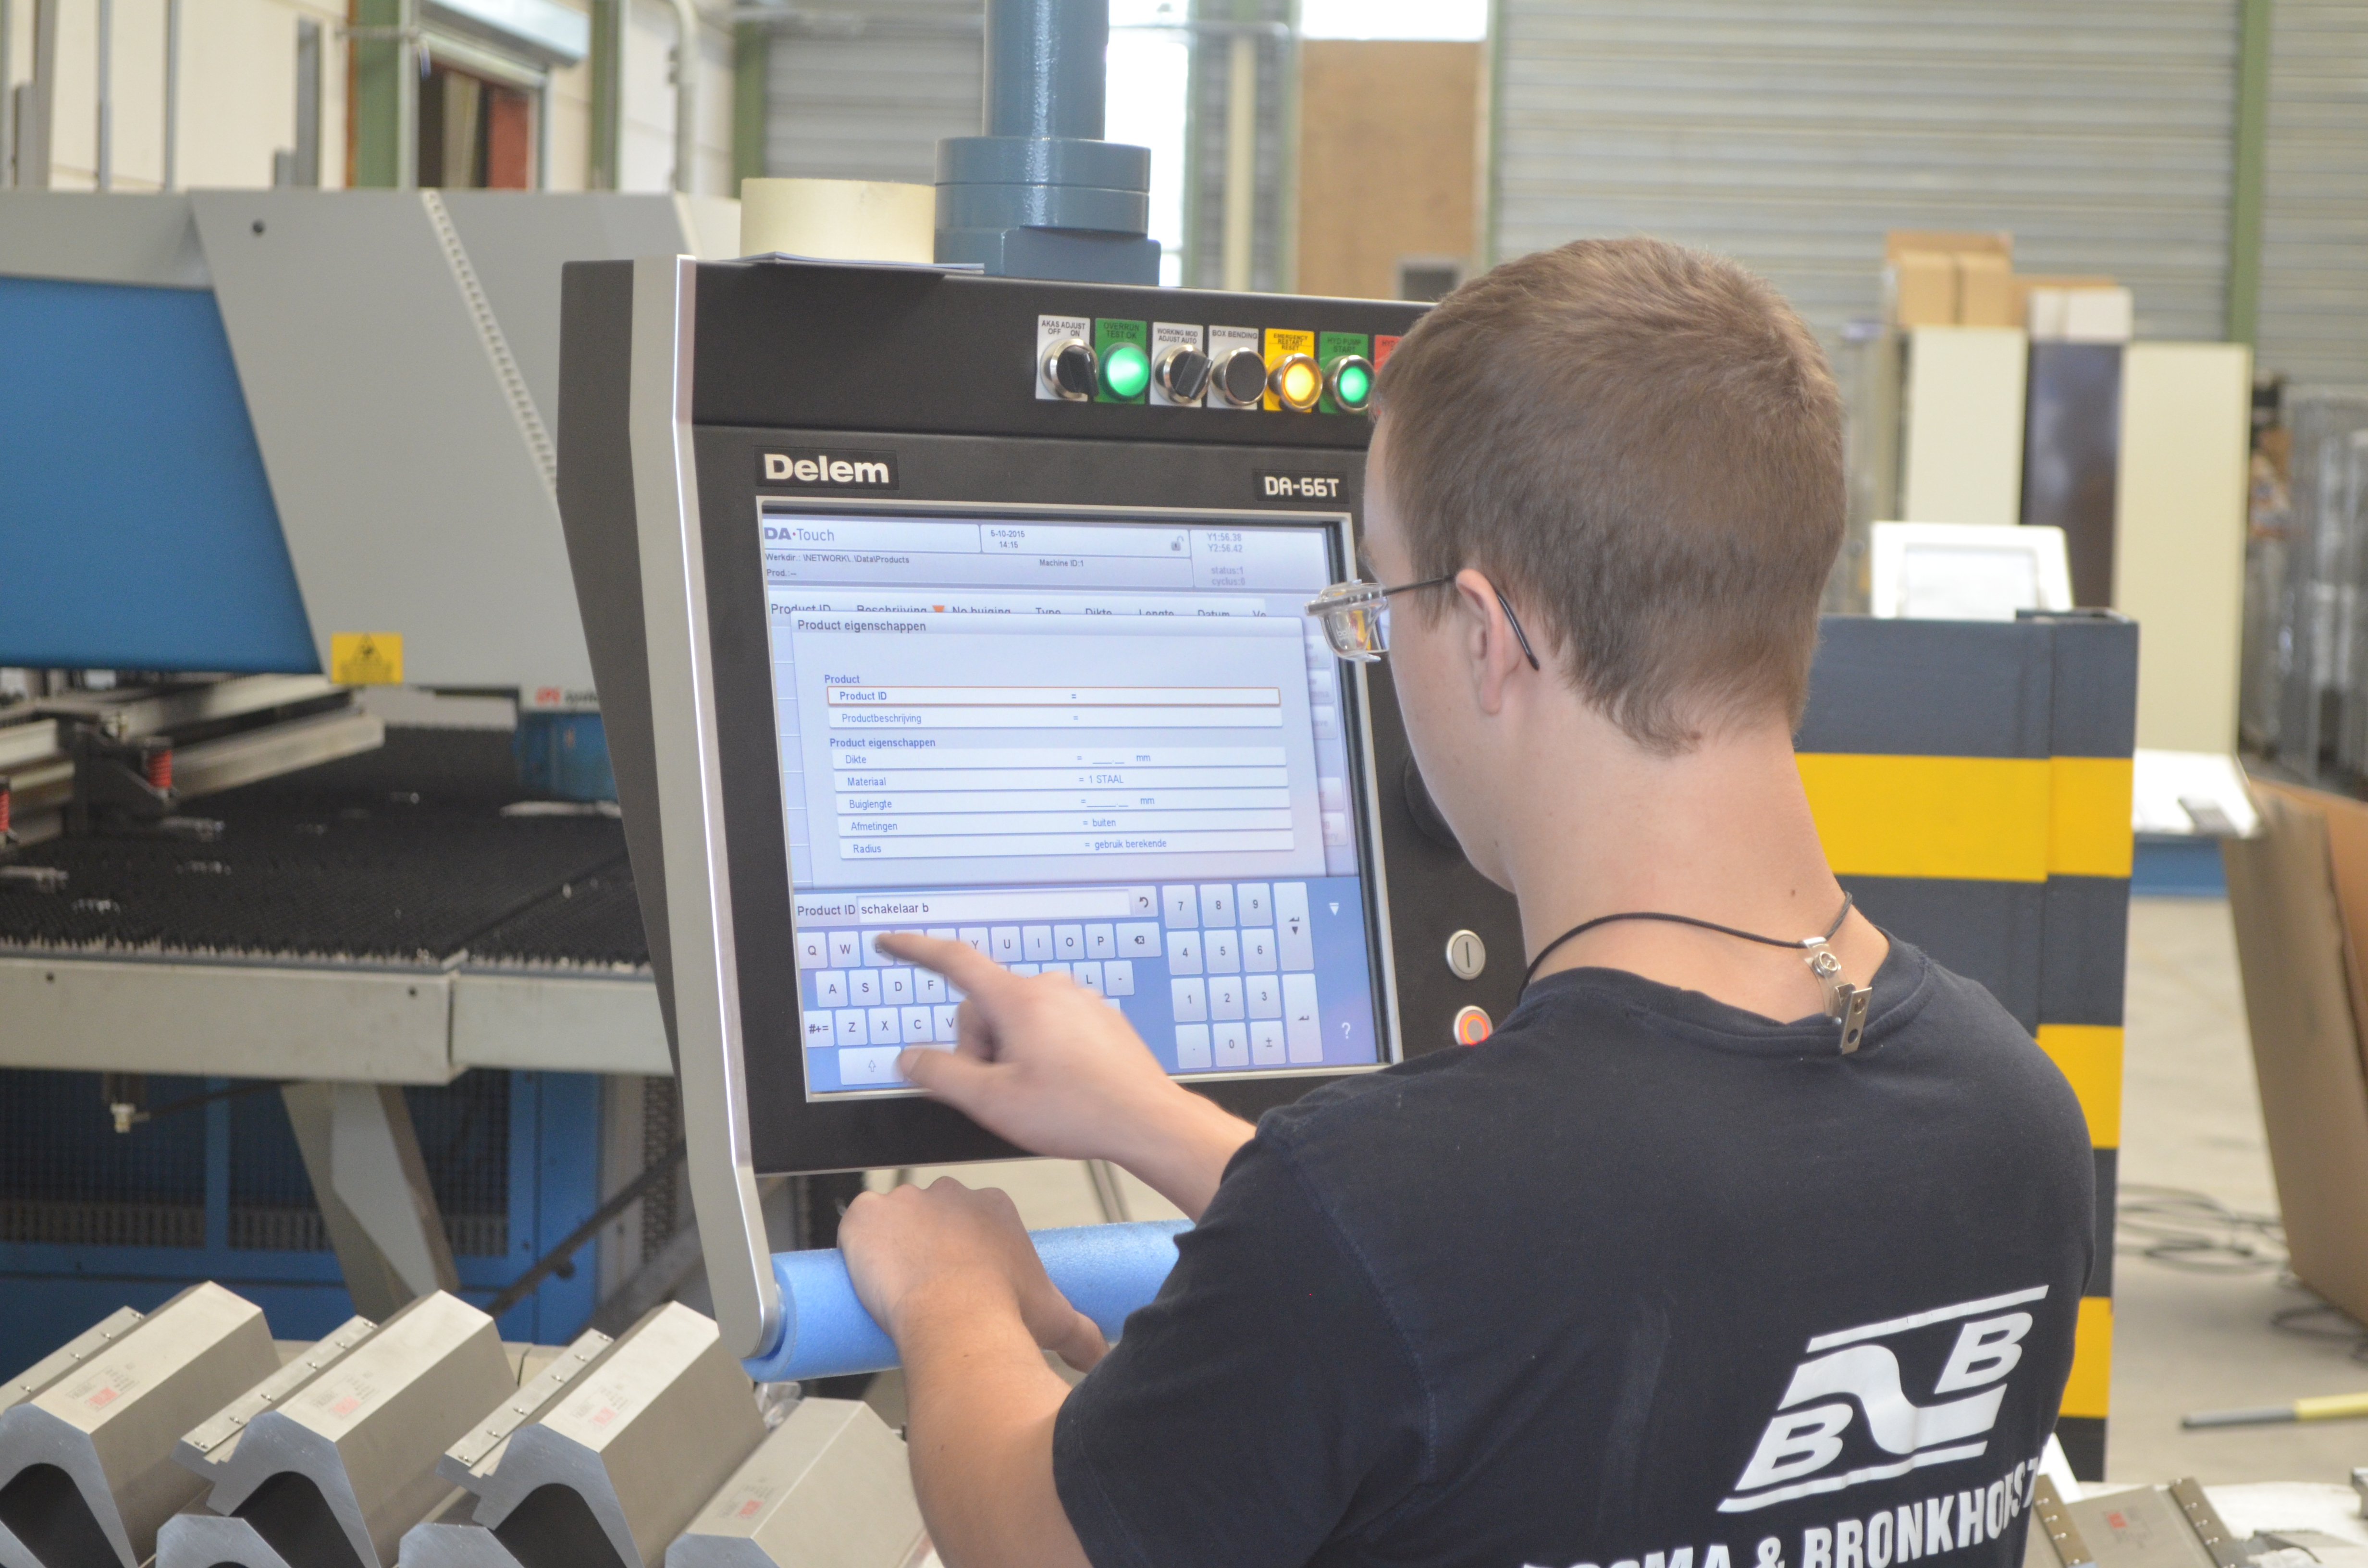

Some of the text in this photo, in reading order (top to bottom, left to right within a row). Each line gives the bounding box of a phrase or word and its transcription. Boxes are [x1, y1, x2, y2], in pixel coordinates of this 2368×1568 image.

[1061, 321, 1086, 329] ADJUST
[1103, 322, 1140, 331] OVERRUN
[1228, 331, 1258, 339] BENDING
[764, 453, 889, 483] Delem
[1265, 476, 1340, 498] DA-66T
[1207, 532, 1242, 541] Y1:56.38
[1208, 544, 1243, 552] Y2:56.42
[1211, 566, 1244, 575] status:1
[771, 603, 816, 614] Product
[797, 620, 926, 633] Product eigenschappen
[825, 674, 860, 684] Product
[839, 691, 876, 700] Product
[877, 691, 887, 700] ID
[841, 714, 922, 724] Productbeschrijving
[829, 738, 936, 749] Product eigenschappen
[845, 755, 867, 764] Dikte
[847, 777, 887, 786] Materiaal
[1089, 775, 1093, 784] 1
[1096, 774, 1124, 784] STAAL
[849, 799, 892, 810] Buiglengte
[851, 821, 898, 832] Afmetingen
[1092, 818, 1116, 827] buiten
[853, 844, 881, 854] Radius
[1095, 840, 1123, 851] gebruik
[1126, 839, 1167, 848] berekende
[797, 902, 929, 916] Product ID schakelaar b
[1178, 901, 1184, 911] 7
[1216, 900, 1221, 910] 8
[1252, 899, 1258, 909] 9
[971, 940, 979, 950] Y
[1003, 939, 1011, 949] U
[1066, 937, 1074, 947] O
[1097, 936, 1104, 946] P
[808, 945, 817, 956] Q
[839, 944, 851, 955] W
[1182, 948, 1188, 957] 4
[1220, 946, 1226, 956] 5
[1257, 945, 1263, 955] 6
[1086, 974, 1093, 984] L
[828, 983, 837, 994] A
[862, 982, 870, 993] S
[895, 981, 903, 992] D
[927, 980, 934, 990] F
[1187, 994, 1192, 1004] 1
[1224, 993, 1231, 1003] 2
[1261, 992, 1268, 1001] 3
[848, 1022, 856, 1032] Z
[881, 1021, 889, 1031] X
[913, 1019, 922, 1030] C
[946, 1017, 955, 1028] V
[1228, 1039, 1235, 1049] 0
[1934, 1311, 2033, 1395] B
[1734, 1403, 1853, 1492] B
